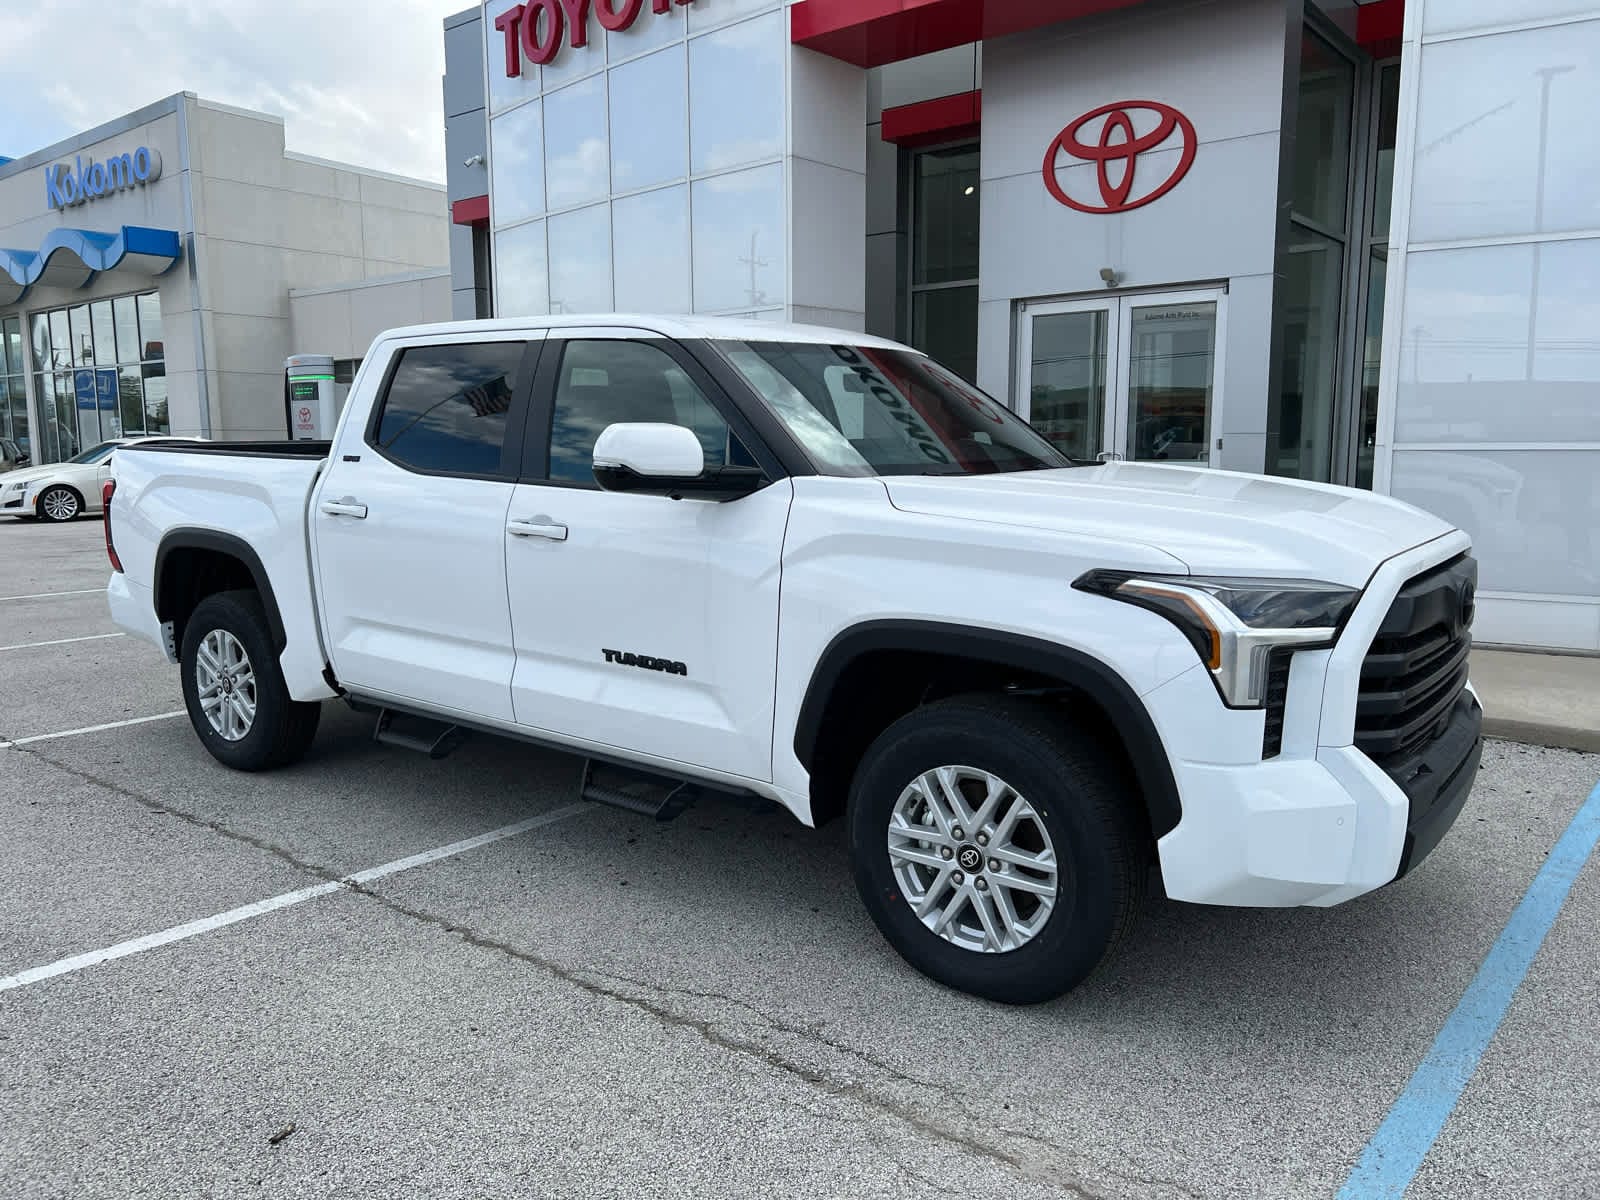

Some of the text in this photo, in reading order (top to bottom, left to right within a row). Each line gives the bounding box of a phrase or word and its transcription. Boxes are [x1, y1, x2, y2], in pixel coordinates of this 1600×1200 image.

[495, 0, 695, 78] TOY
[45, 146, 153, 209] Kokomo
[601, 648, 687, 676] TUNDRA
